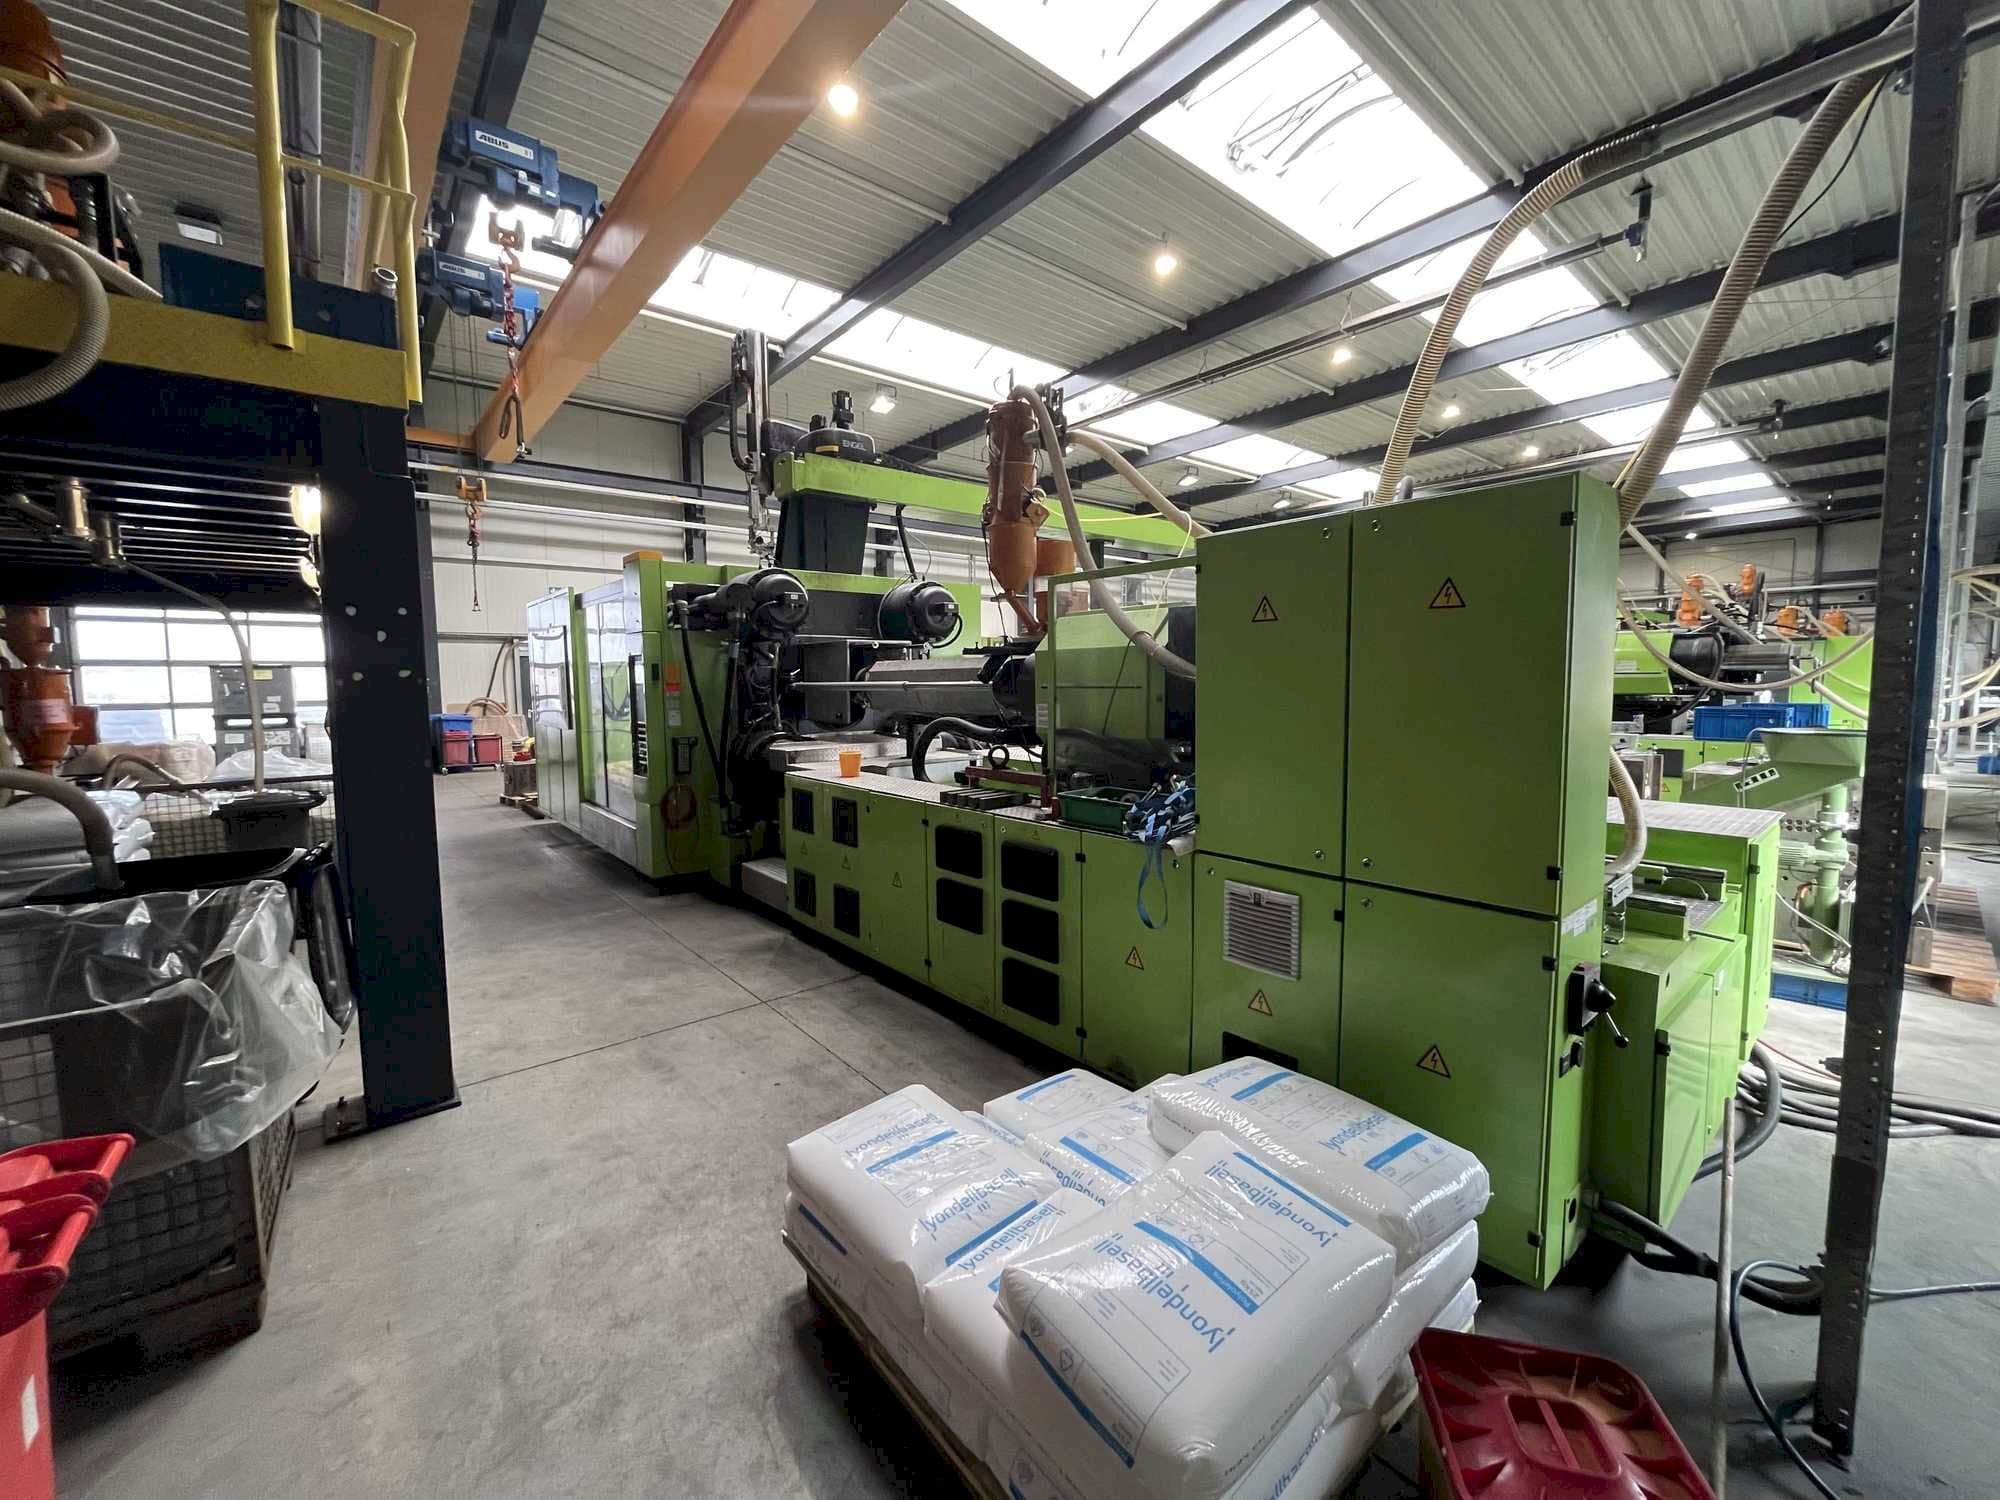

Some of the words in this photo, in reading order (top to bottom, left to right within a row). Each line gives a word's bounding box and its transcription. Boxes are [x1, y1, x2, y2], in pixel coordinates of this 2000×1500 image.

[479, 134, 510, 149] ABUS
[918, 1166, 1022, 1236] lyondellbasell
[1204, 1163, 1335, 1247] lyondellbasell
[957, 1203, 1061, 1271] lyondellbasell
[1092, 1238, 1227, 1353] lyondellbasell
